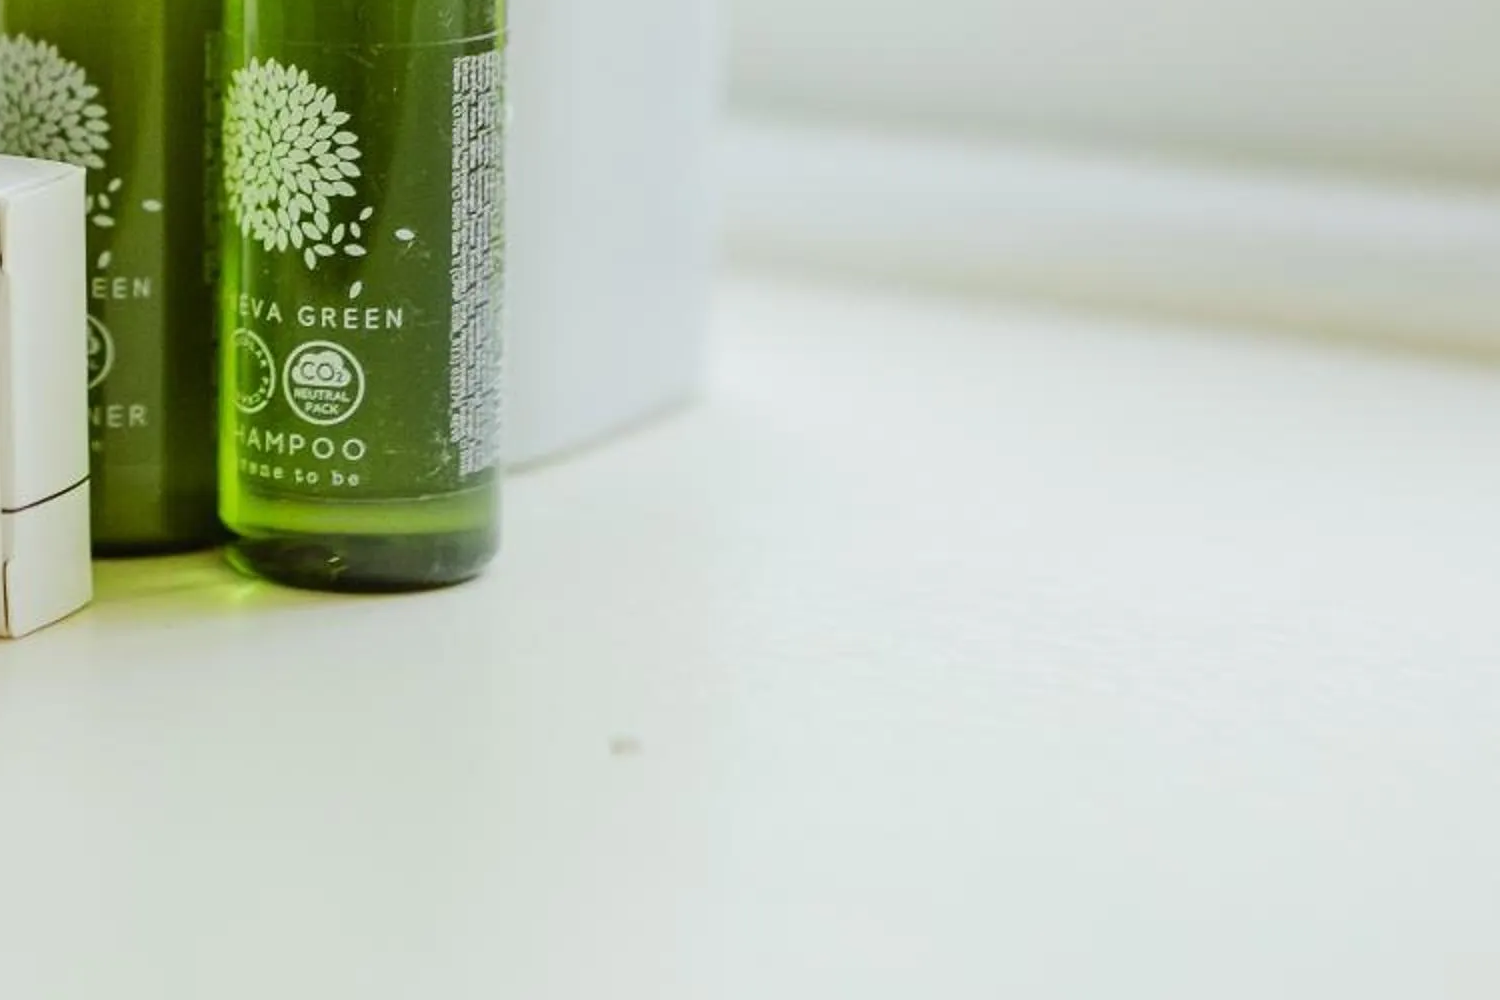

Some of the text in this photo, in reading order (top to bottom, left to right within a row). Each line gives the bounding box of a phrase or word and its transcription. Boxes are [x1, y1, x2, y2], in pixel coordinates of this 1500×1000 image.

[297, 305, 403, 329] GREEN
[294, 388, 350, 403] NEUTRAL
[305, 401, 340, 415] PACK
[294, 468, 319, 484] to
[331, 469, 360, 487] be
